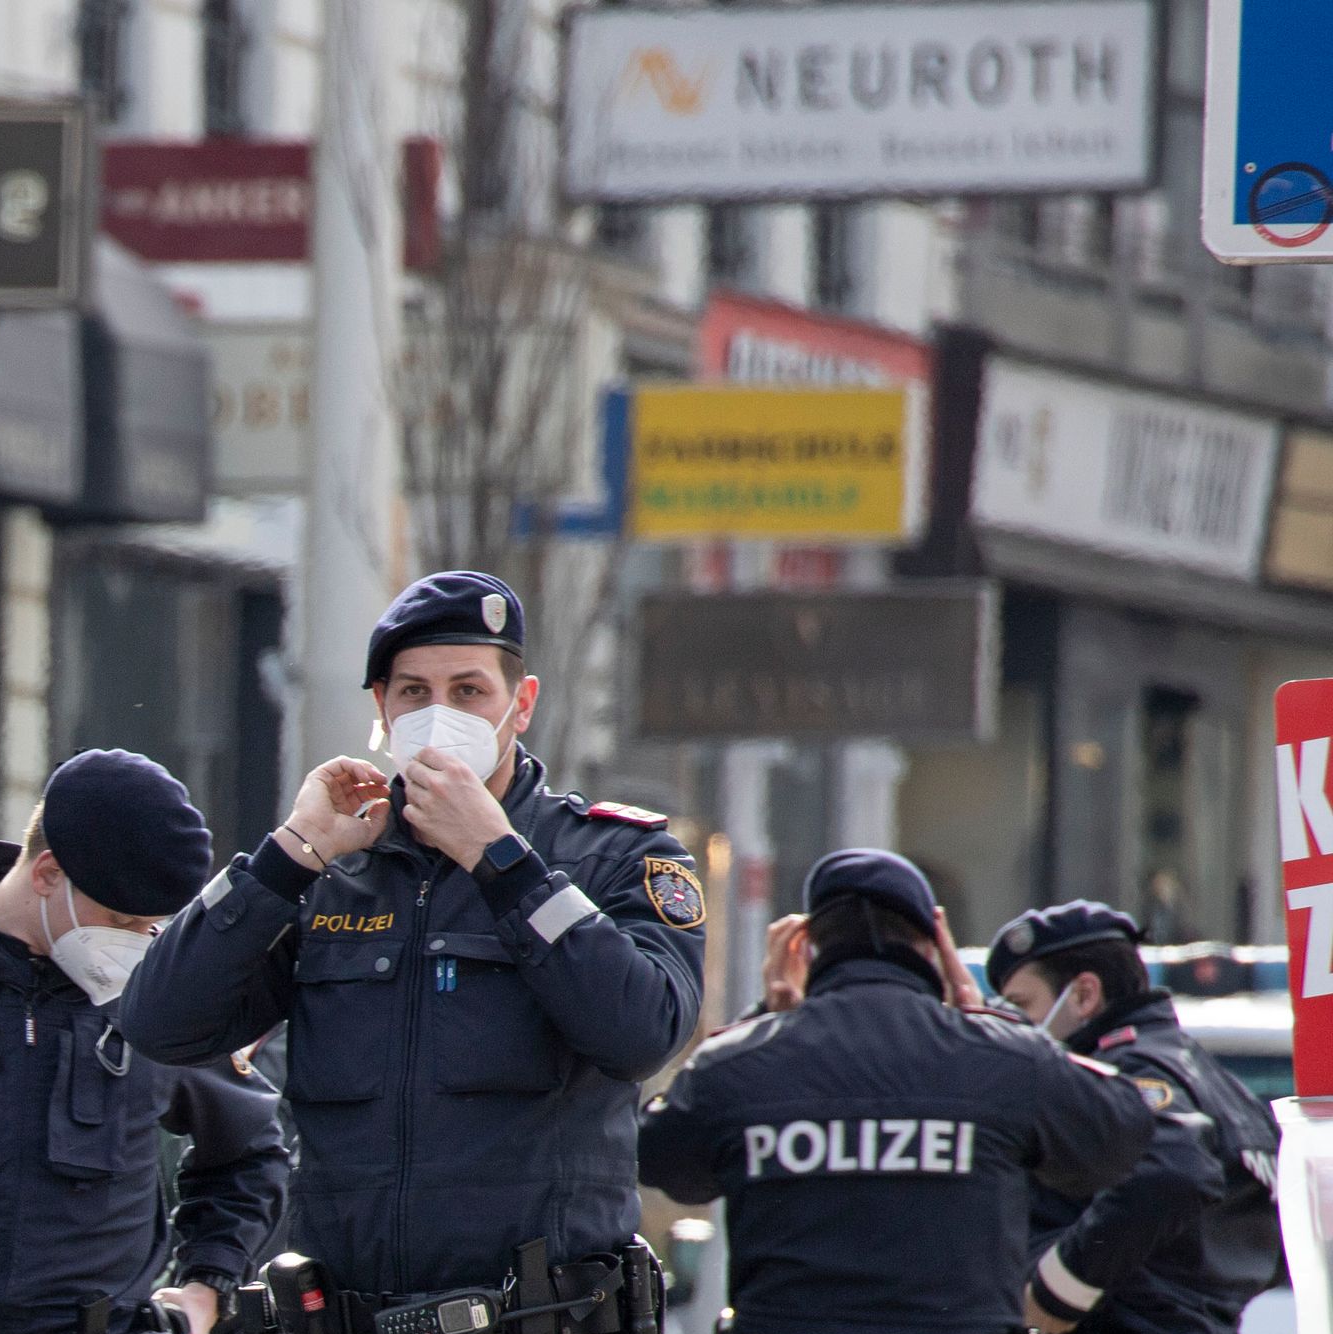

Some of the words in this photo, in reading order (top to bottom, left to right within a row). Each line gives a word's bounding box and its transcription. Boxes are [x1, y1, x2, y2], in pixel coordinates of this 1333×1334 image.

[735, 34, 1120, 113] NEUROTH
[311, 912, 394, 932] POLIZEI
[744, 1119, 975, 1177] POLIZEI
